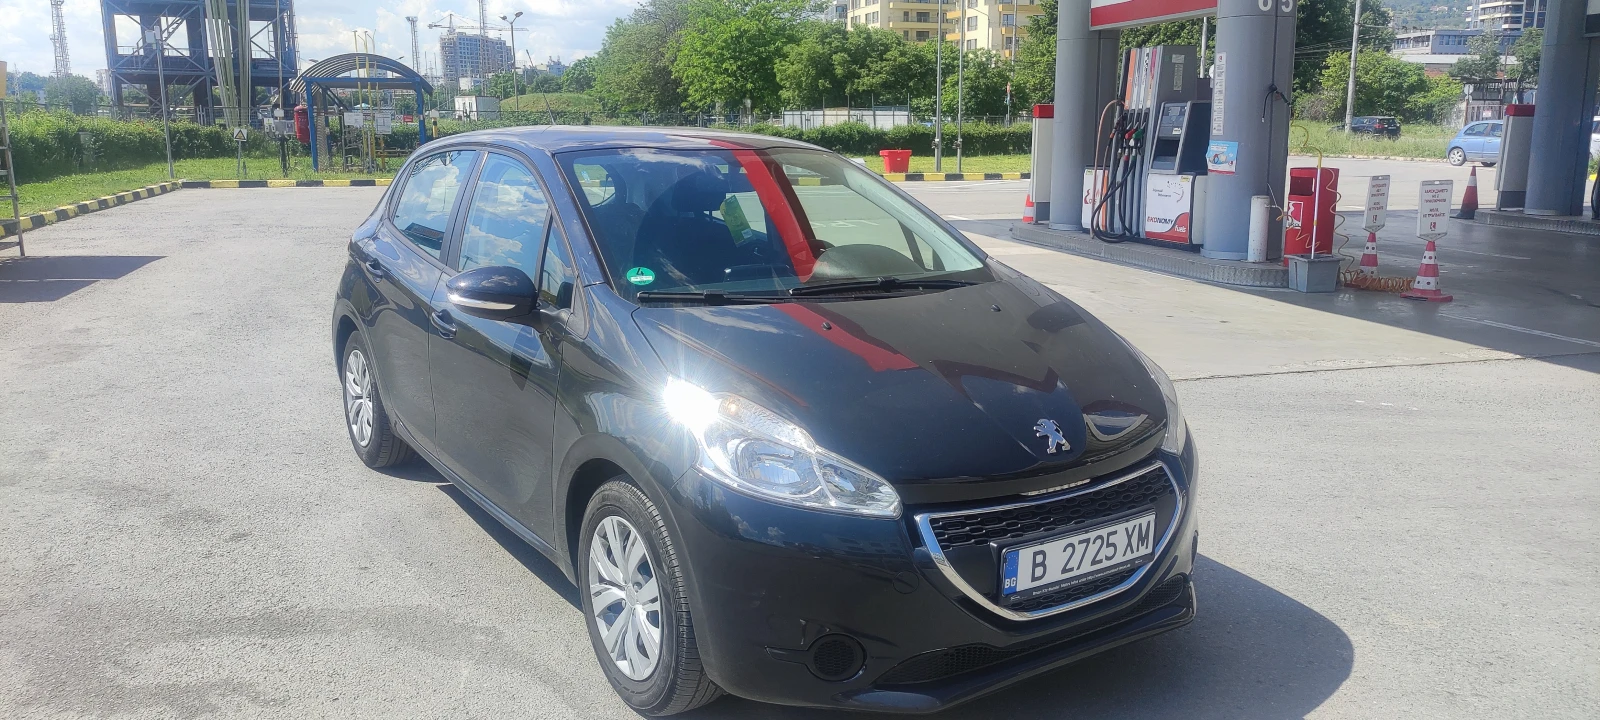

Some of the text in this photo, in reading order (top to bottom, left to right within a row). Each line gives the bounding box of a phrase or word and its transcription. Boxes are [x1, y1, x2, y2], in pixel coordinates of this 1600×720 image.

[1147, 216, 1174, 225] EKONOMY
[1174, 224, 1187, 232] fuels
[636, 267, 645, 276] 4
[1031, 550, 1046, 582] B
[1061, 530, 1117, 574] 2725
[1123, 521, 1150, 557] XM
[1005, 577, 1016, 588] BG
